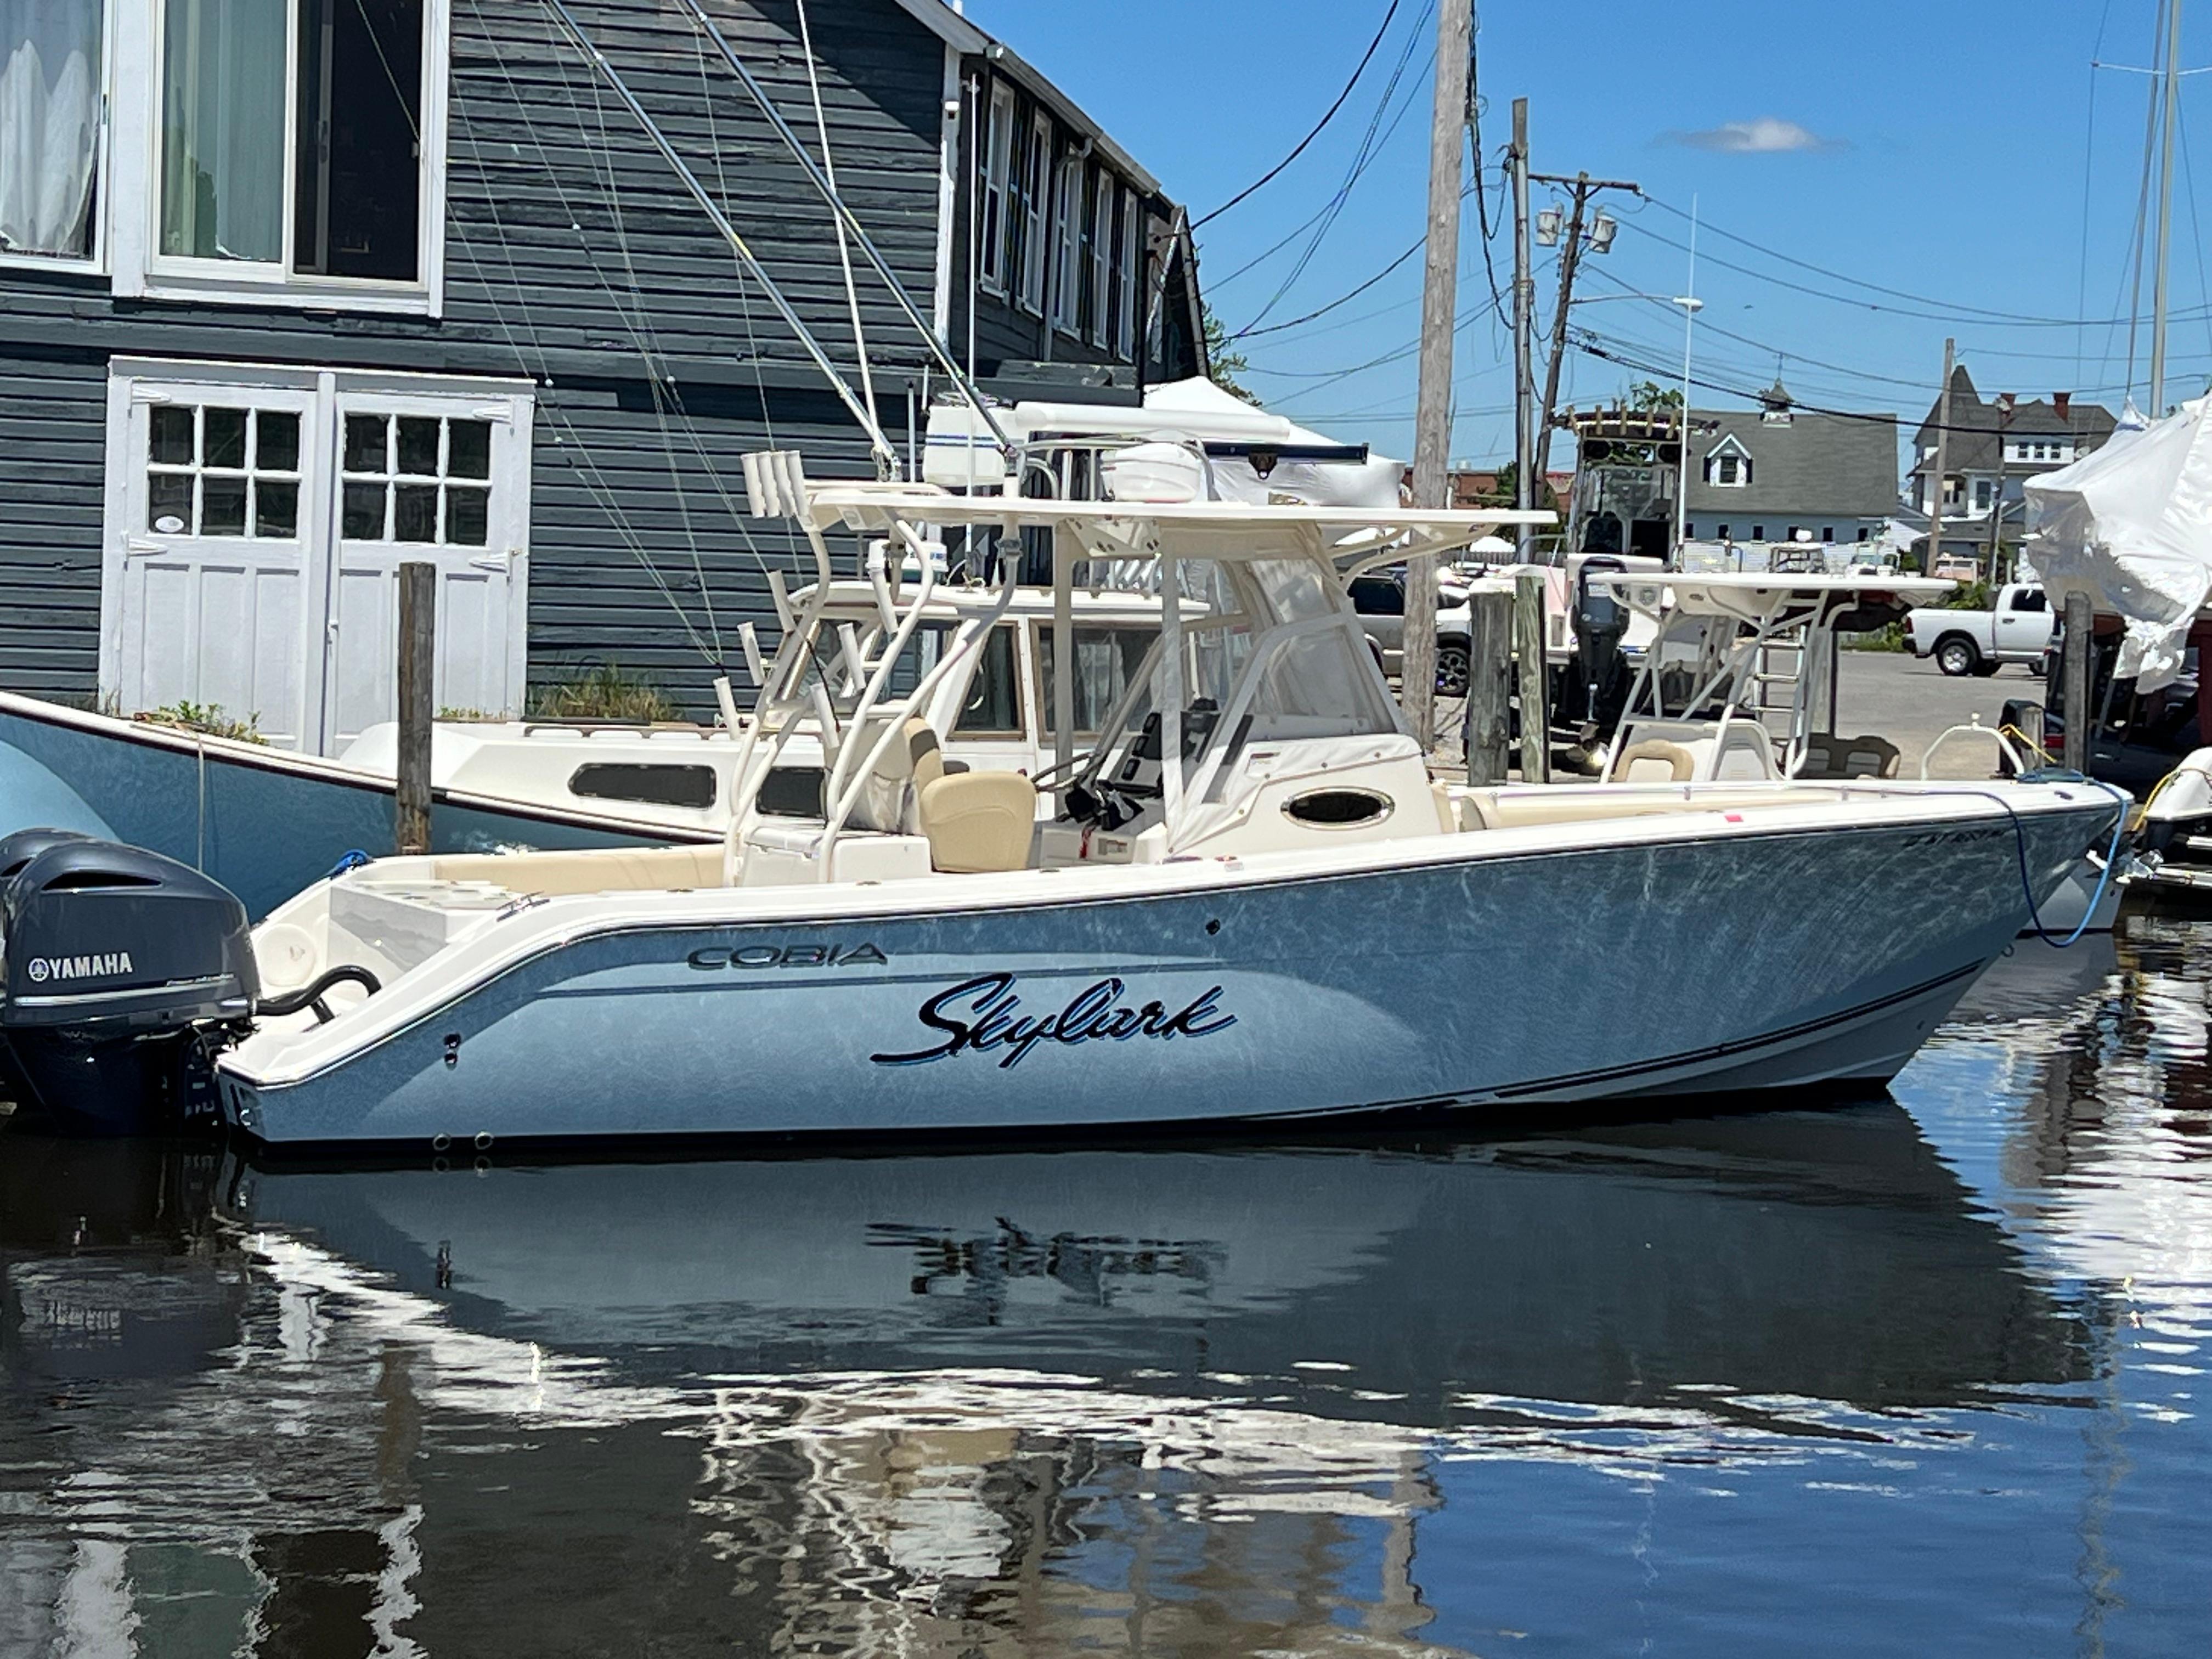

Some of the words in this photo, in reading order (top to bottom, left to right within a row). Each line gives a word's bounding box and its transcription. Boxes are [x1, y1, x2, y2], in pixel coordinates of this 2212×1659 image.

[48, 952, 133, 979] YAMAHA
[687, 943, 888, 970] COBIA
[870, 972, 1238, 1070] Skylark
